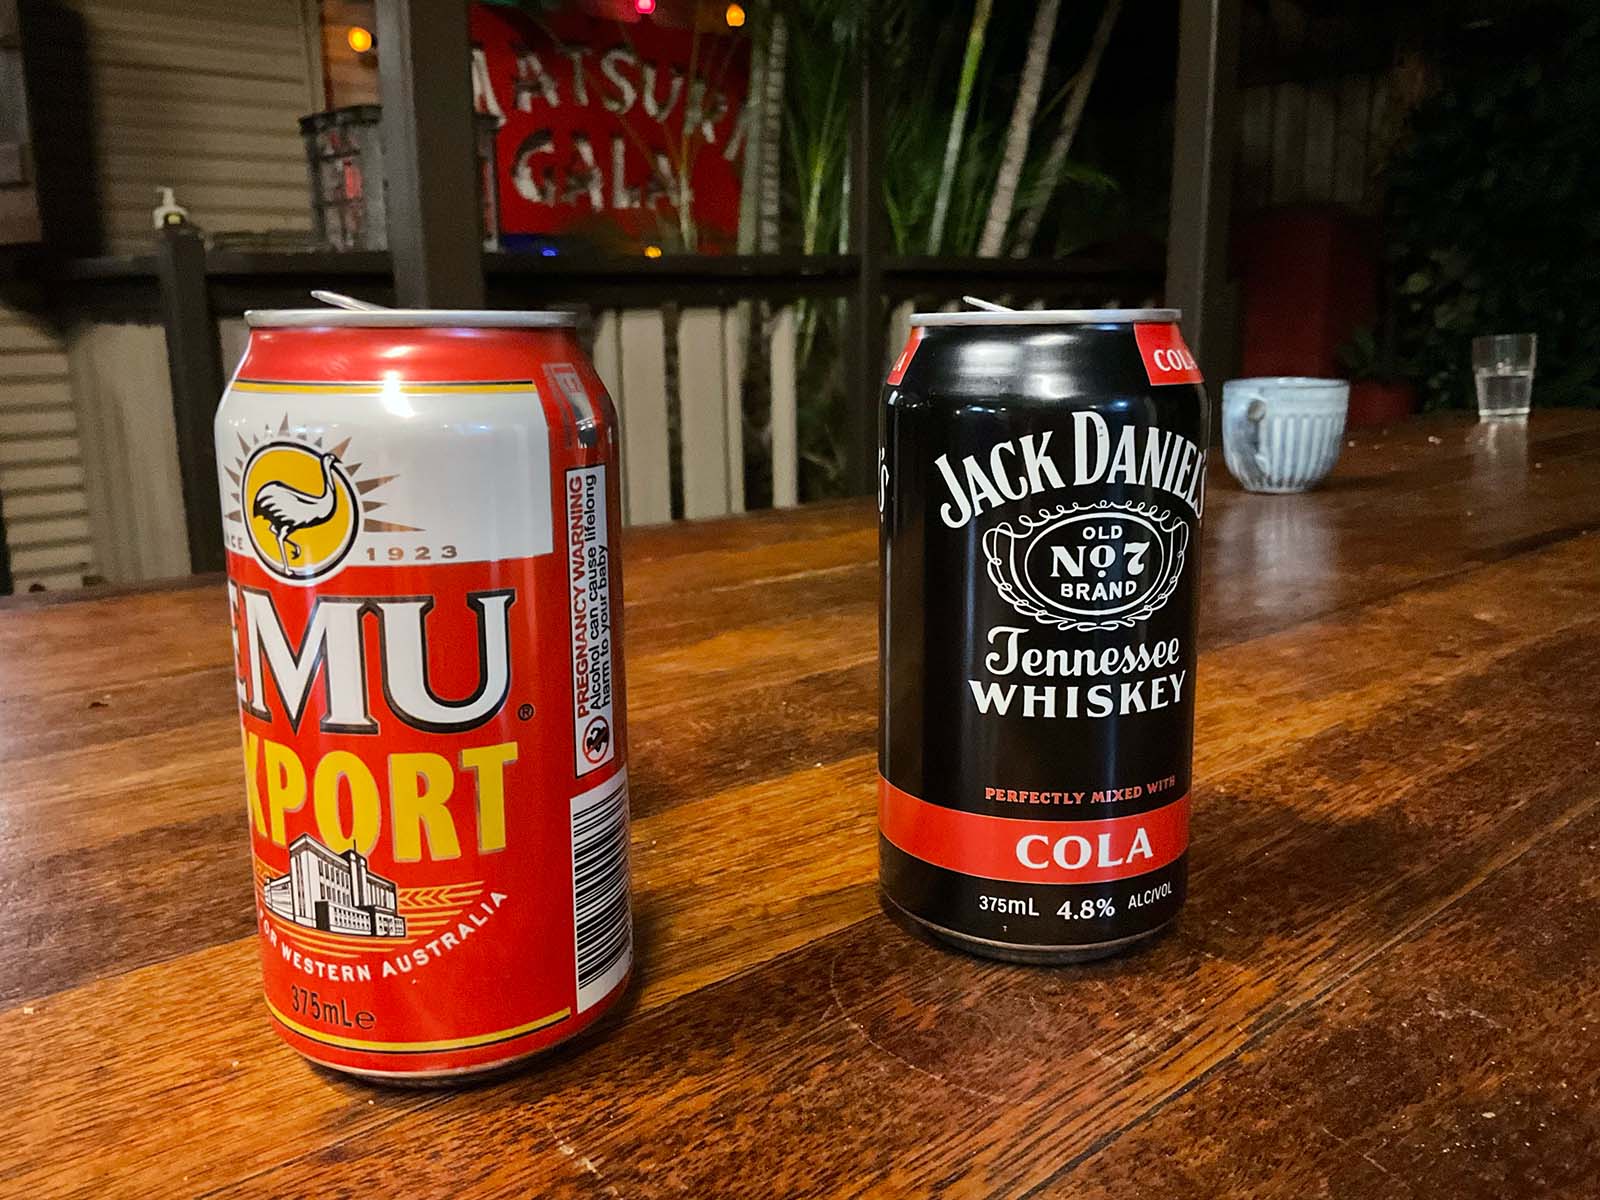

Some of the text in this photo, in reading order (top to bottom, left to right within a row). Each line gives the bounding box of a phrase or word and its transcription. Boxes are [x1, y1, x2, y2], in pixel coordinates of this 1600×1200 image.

[513, 131, 690, 212] GALA
[934, 431, 1066, 529] JACK
[366, 545, 458, 561] 1923
[1082, 525, 1123, 540] OLD
[569, 475, 590, 718] PREGNANCY WARNING
[584, 474, 602, 710] Alcohol can cause lifelong
[1061, 580, 1137, 600] BRAND
[598, 545, 611, 707] harm to your baby
[985, 626, 1180, 677] Tennessee
[968, 670, 1187, 718] WHISKEY
[985, 775, 1176, 804] PERFECTLY MIXED WITH
[1015, 827, 1153, 870] COLA
[979, 895, 1040, 917] 375mL
[1056, 897, 1116, 920] 4.8%
[282, 942, 372, 982] WESTERN
[382, 891, 509, 978] AUSTRALIA
